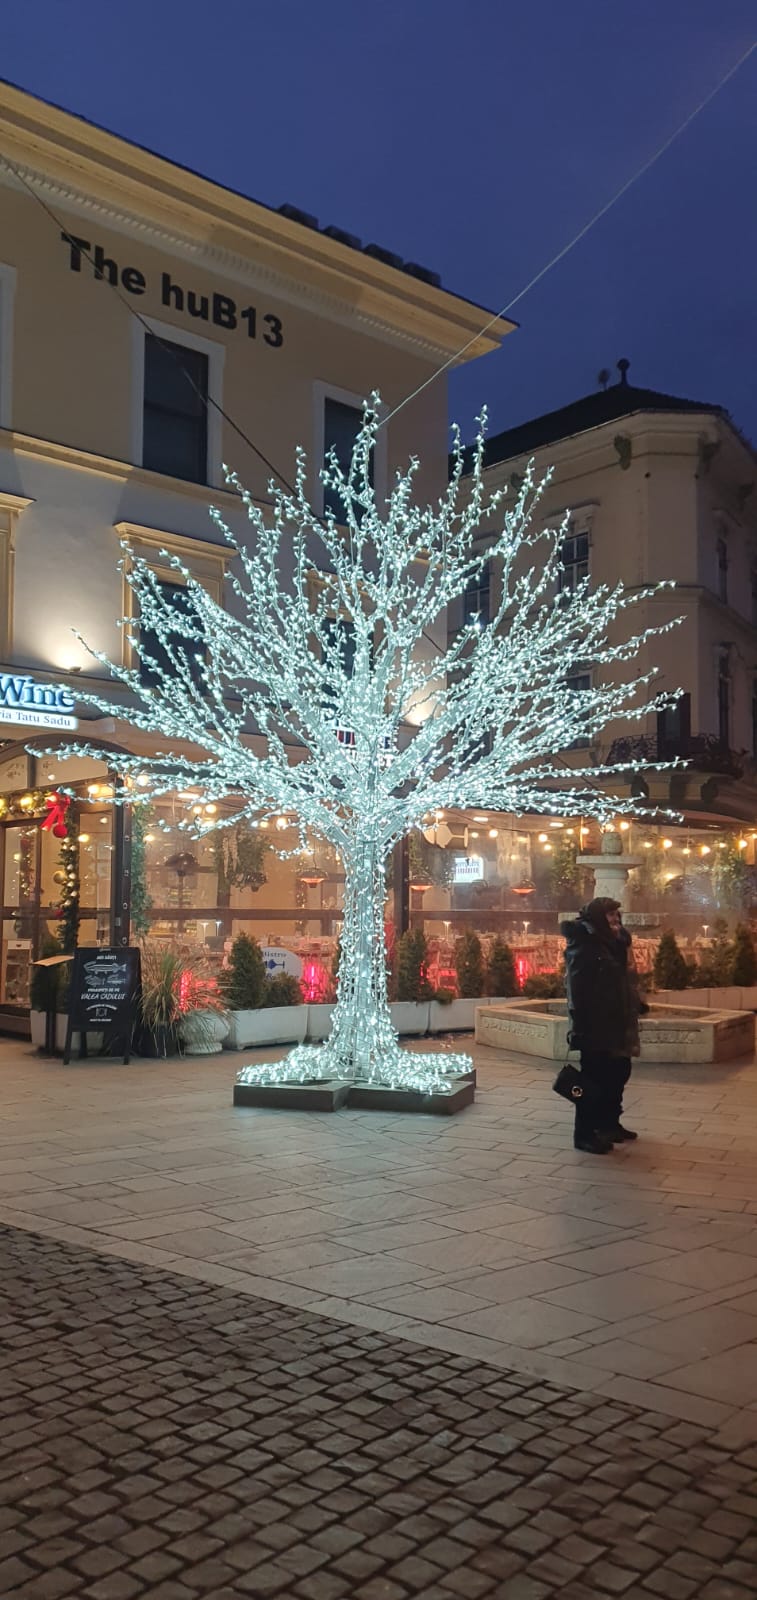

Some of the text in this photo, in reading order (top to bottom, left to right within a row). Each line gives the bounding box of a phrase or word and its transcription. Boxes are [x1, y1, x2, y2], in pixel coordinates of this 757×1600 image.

[61, 231, 284, 348] The huB13
[0, 676, 75, 707] Wine
[16, 711, 40, 723] Tatu
[43, 715, 71, 727] Sadu
